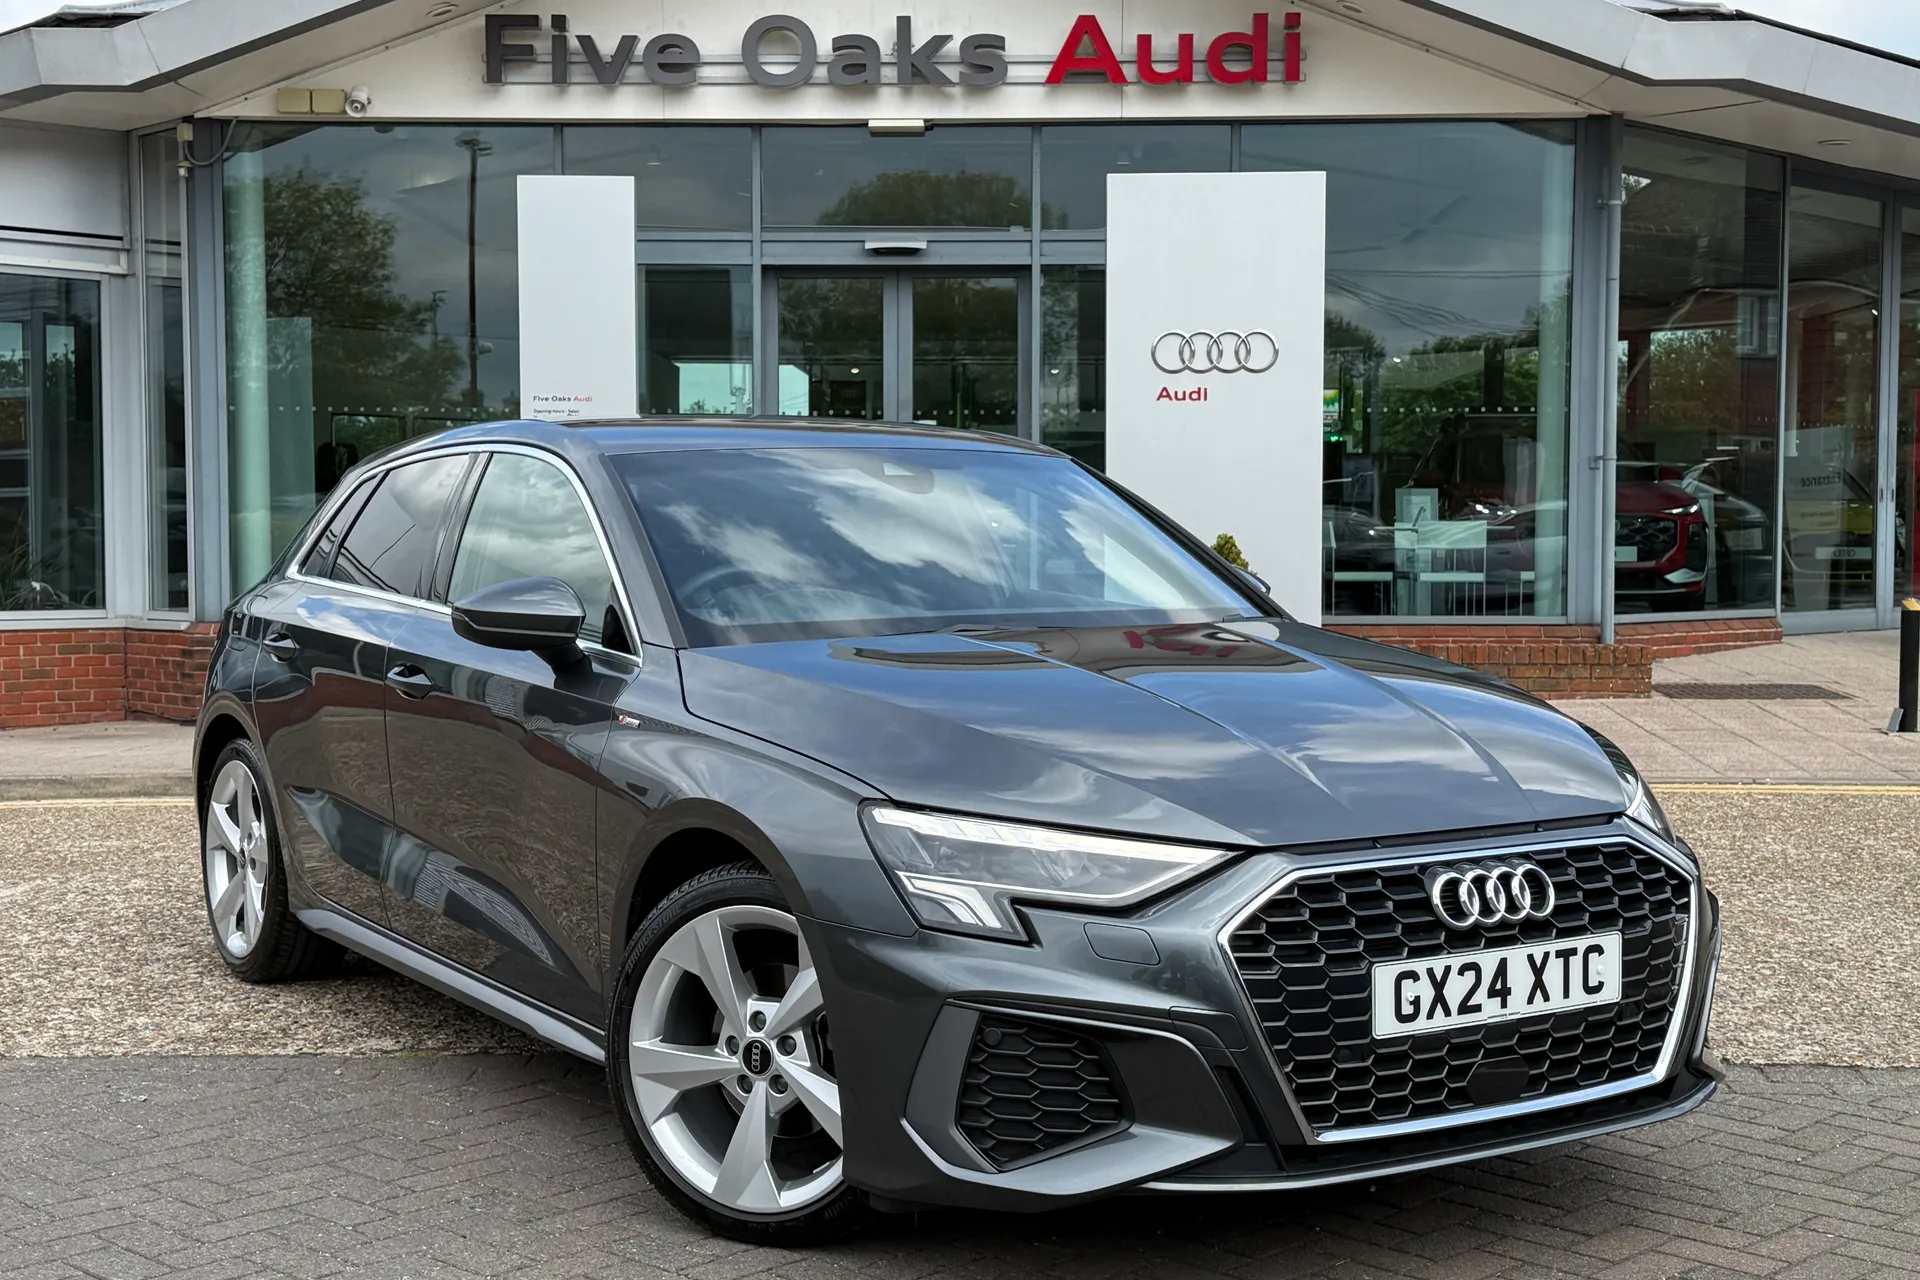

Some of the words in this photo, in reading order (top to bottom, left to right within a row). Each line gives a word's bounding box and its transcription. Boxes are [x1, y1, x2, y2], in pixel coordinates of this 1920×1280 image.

[485, 14, 701, 87] Five
[741, 14, 1008, 88] Oaks
[1044, 12, 1301, 86] Audi
[1156, 386, 1208, 402] Audi
[1394, 957, 1512, 1024] GX24
[1526, 943, 1606, 1006] XTC
